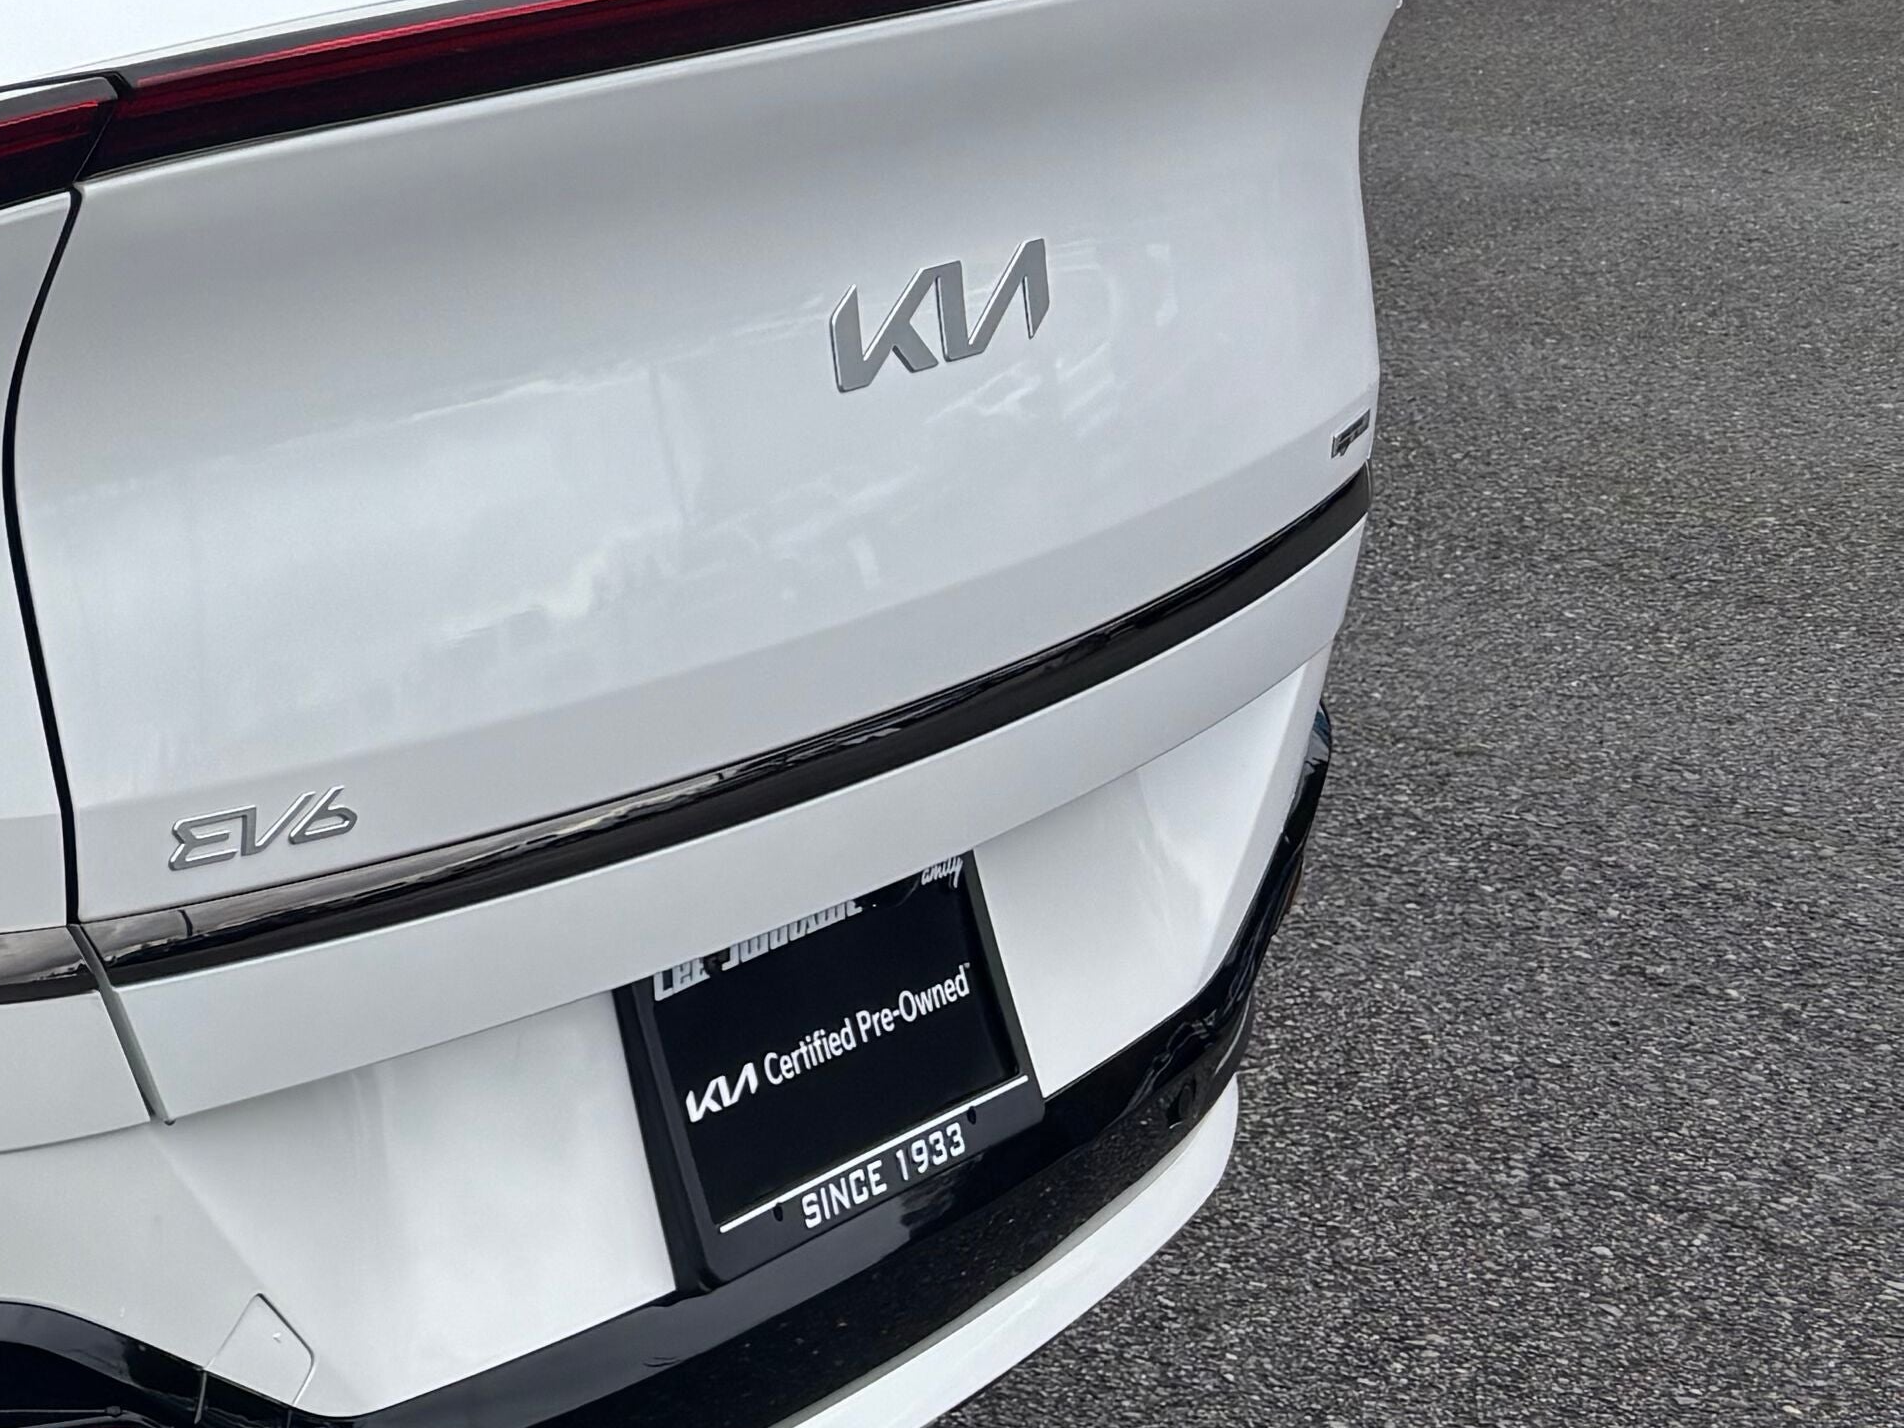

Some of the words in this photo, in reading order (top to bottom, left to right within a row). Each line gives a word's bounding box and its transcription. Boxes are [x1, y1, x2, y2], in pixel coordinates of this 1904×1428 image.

[829, 237, 1050, 393] KIA
[168, 785, 358, 870] EV6
[685, 1062, 758, 1123] KIA
[763, 1018, 856, 1085] Certified
[802, 1160, 887, 1228] SINCE
[895, 1122, 966, 1181] 1933
